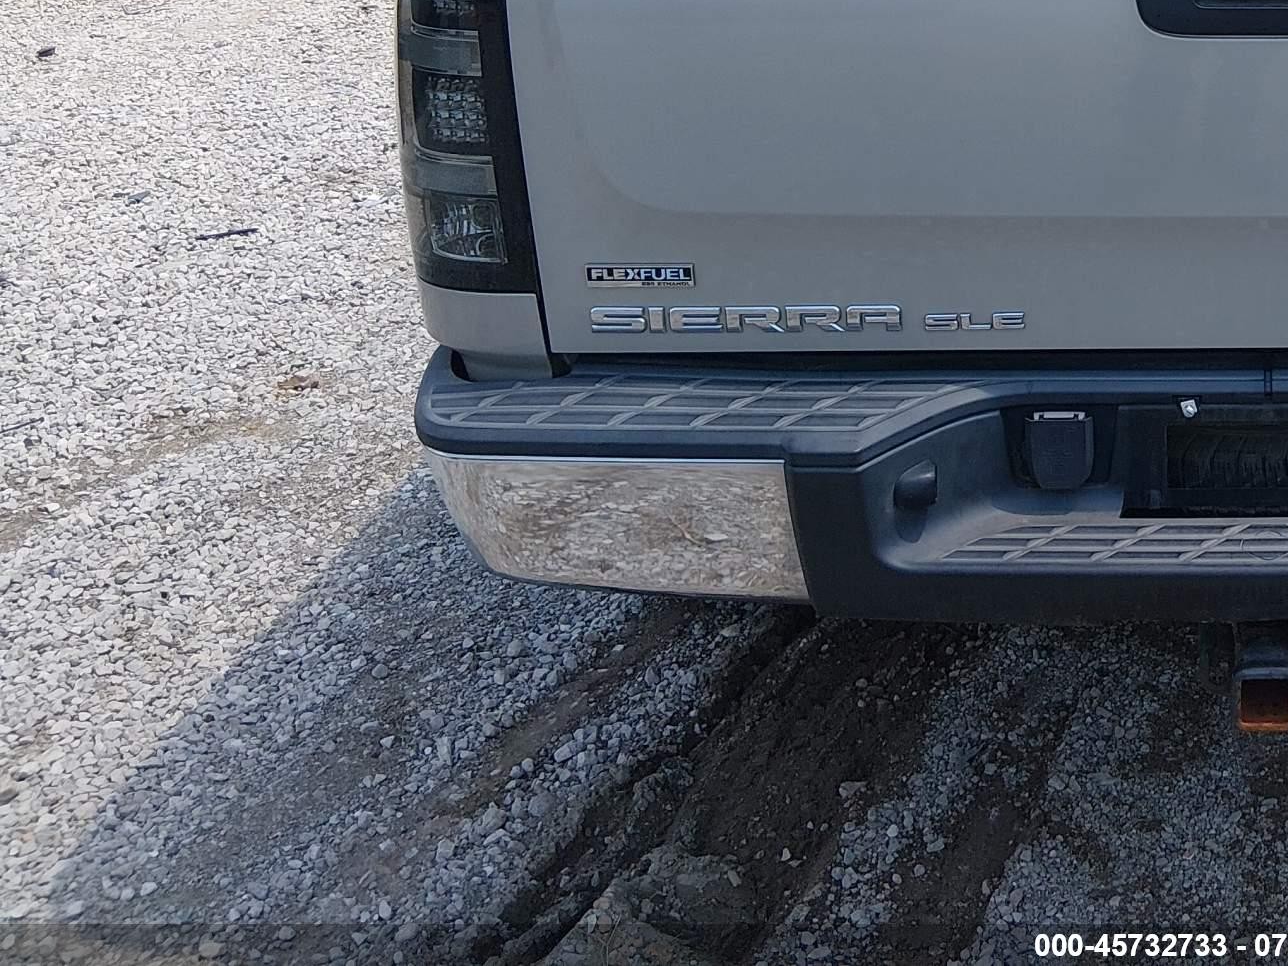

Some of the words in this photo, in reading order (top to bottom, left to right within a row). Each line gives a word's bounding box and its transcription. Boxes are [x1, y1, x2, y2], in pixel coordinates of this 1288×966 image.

[590, 268, 691, 280] FLEXFUEL
[590, 305, 902, 333] SIERRA
[924, 312, 1025, 331] SLE
